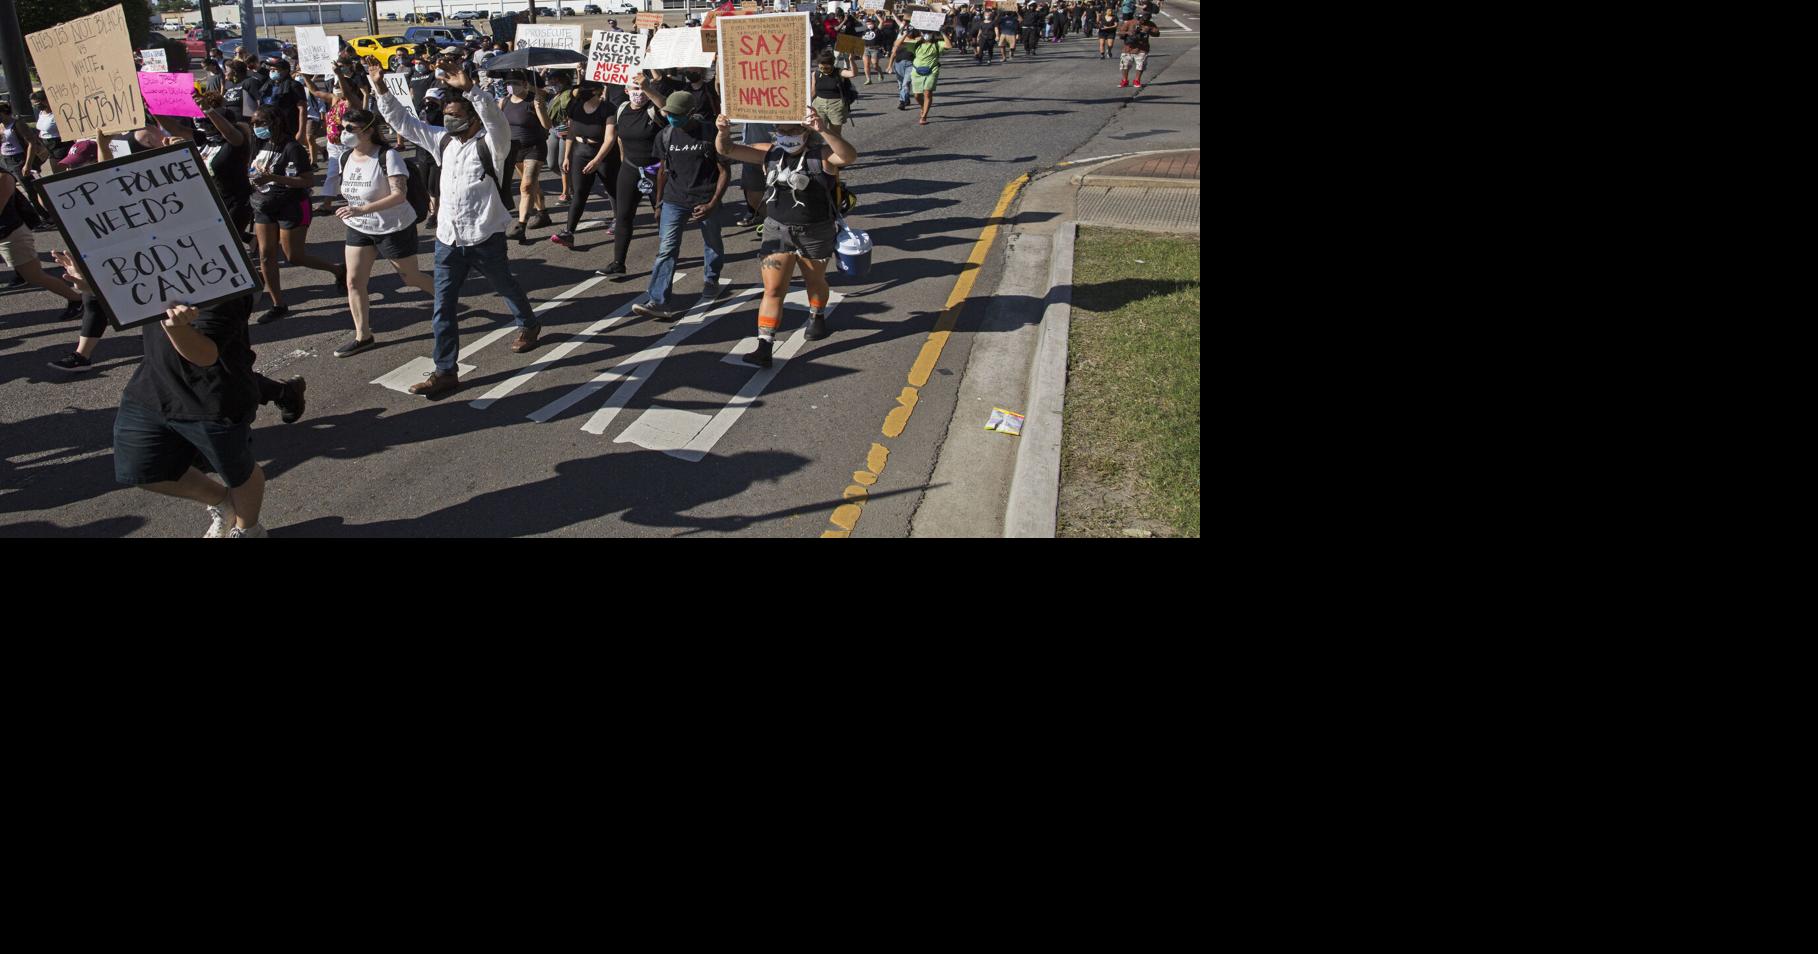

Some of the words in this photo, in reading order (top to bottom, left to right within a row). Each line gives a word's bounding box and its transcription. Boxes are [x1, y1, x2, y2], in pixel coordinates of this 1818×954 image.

[29, 33, 54, 53] THIS
[54, 28, 69, 45] IS
[70, 18, 95, 41] NOT
[94, 7, 127, 35] BLACK
[599, 31, 637, 46] THESE
[595, 42, 640, 56] RACIST
[739, 33, 786, 56] SAY
[71, 55, 104, 78] WHITE.
[592, 51, 641, 66] SYSTEMS
[596, 62, 629, 73] MUST
[738, 59, 790, 81] THEIR
[593, 70, 628, 84] BURN
[47, 83, 69, 103] THIS
[69, 82, 80, 99] IS
[81, 76, 103, 97] ALL
[739, 86, 790, 108] NAMES
[59, 83, 138, 136] RACISM!
[58, 181, 99, 210] JP
[105, 159, 199, 196] POLICE
[85, 191, 184, 239] NEEDS
[102, 235, 203, 285] BODY
[131, 244, 247, 306] CAMS!
